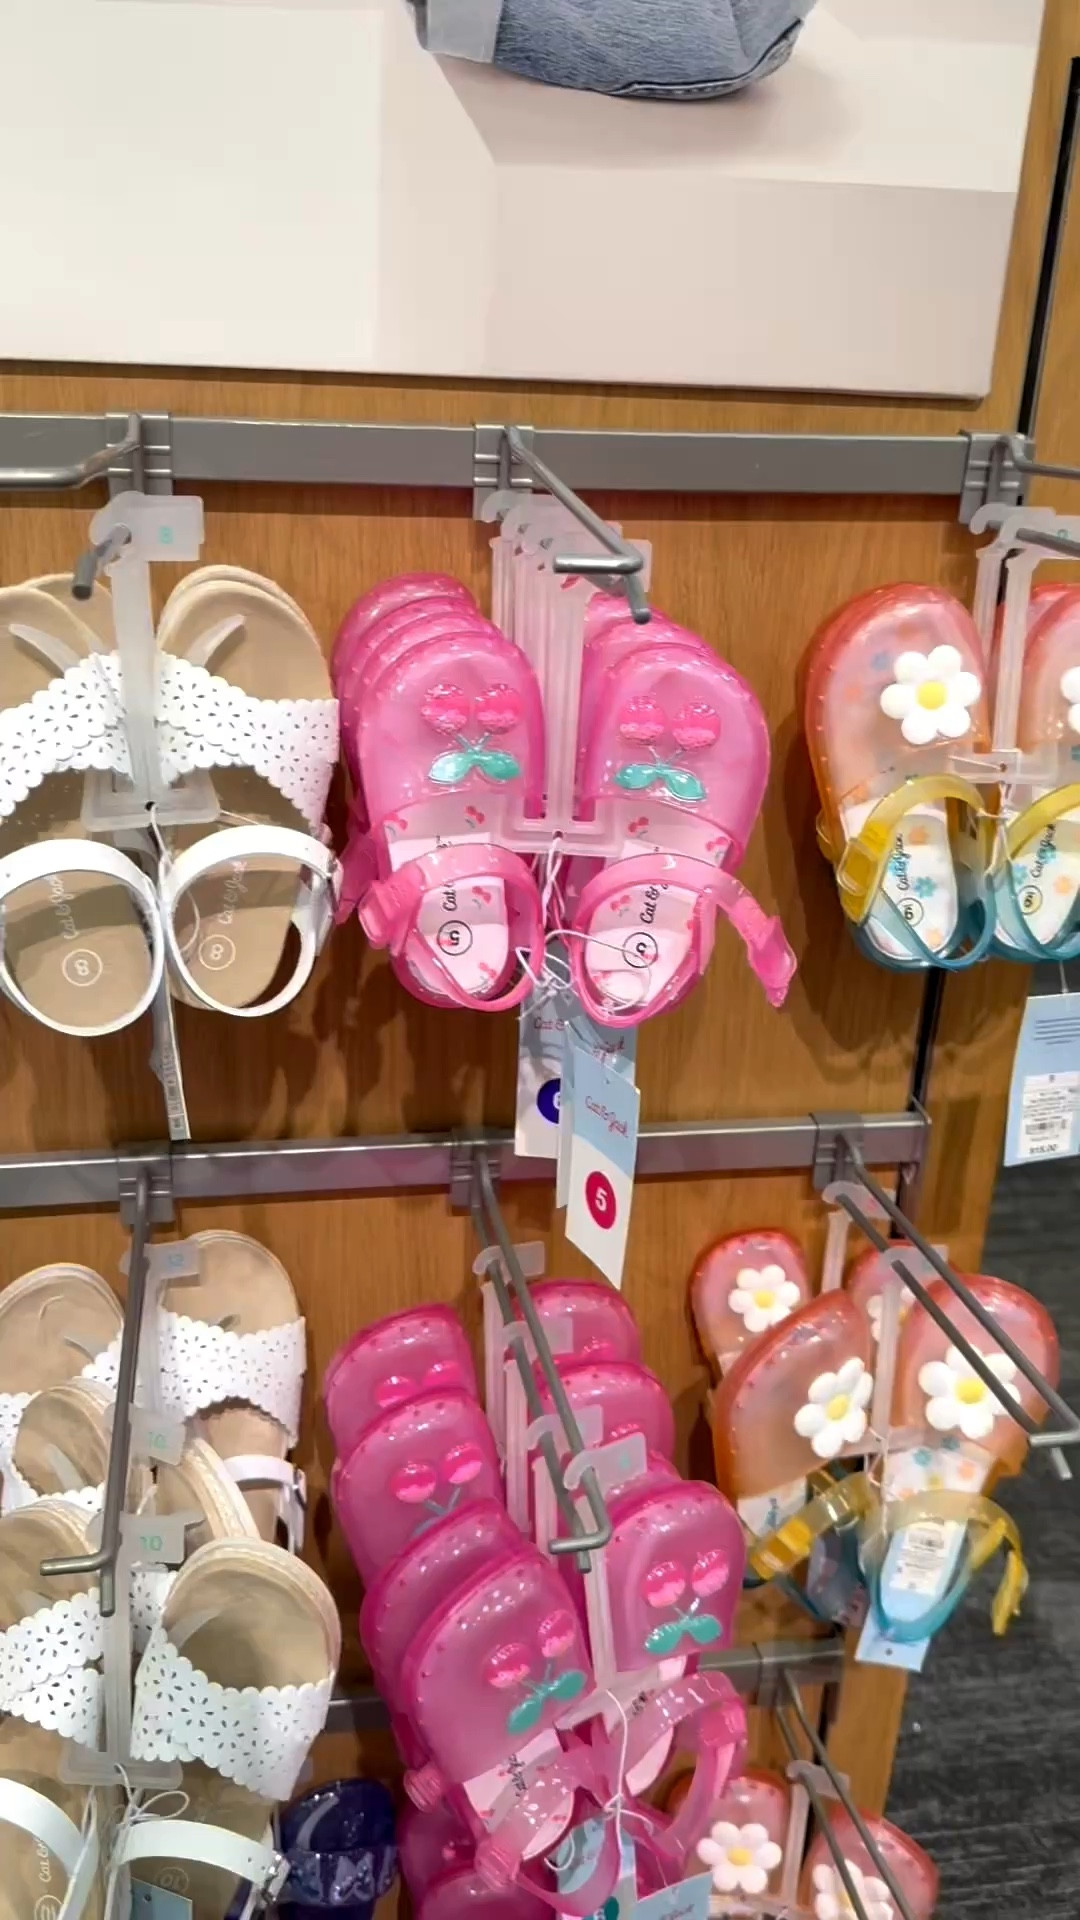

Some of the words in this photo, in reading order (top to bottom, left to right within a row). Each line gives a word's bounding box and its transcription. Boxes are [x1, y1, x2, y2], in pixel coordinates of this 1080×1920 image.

[442, 888, 457, 912] Cat
[640, 901, 657, 924] Cat
[449, 930, 460, 946] 5
[210, 943, 224, 960] 8
[74, 959, 90, 976] 8
[594, 1186, 608, 1212] 5
